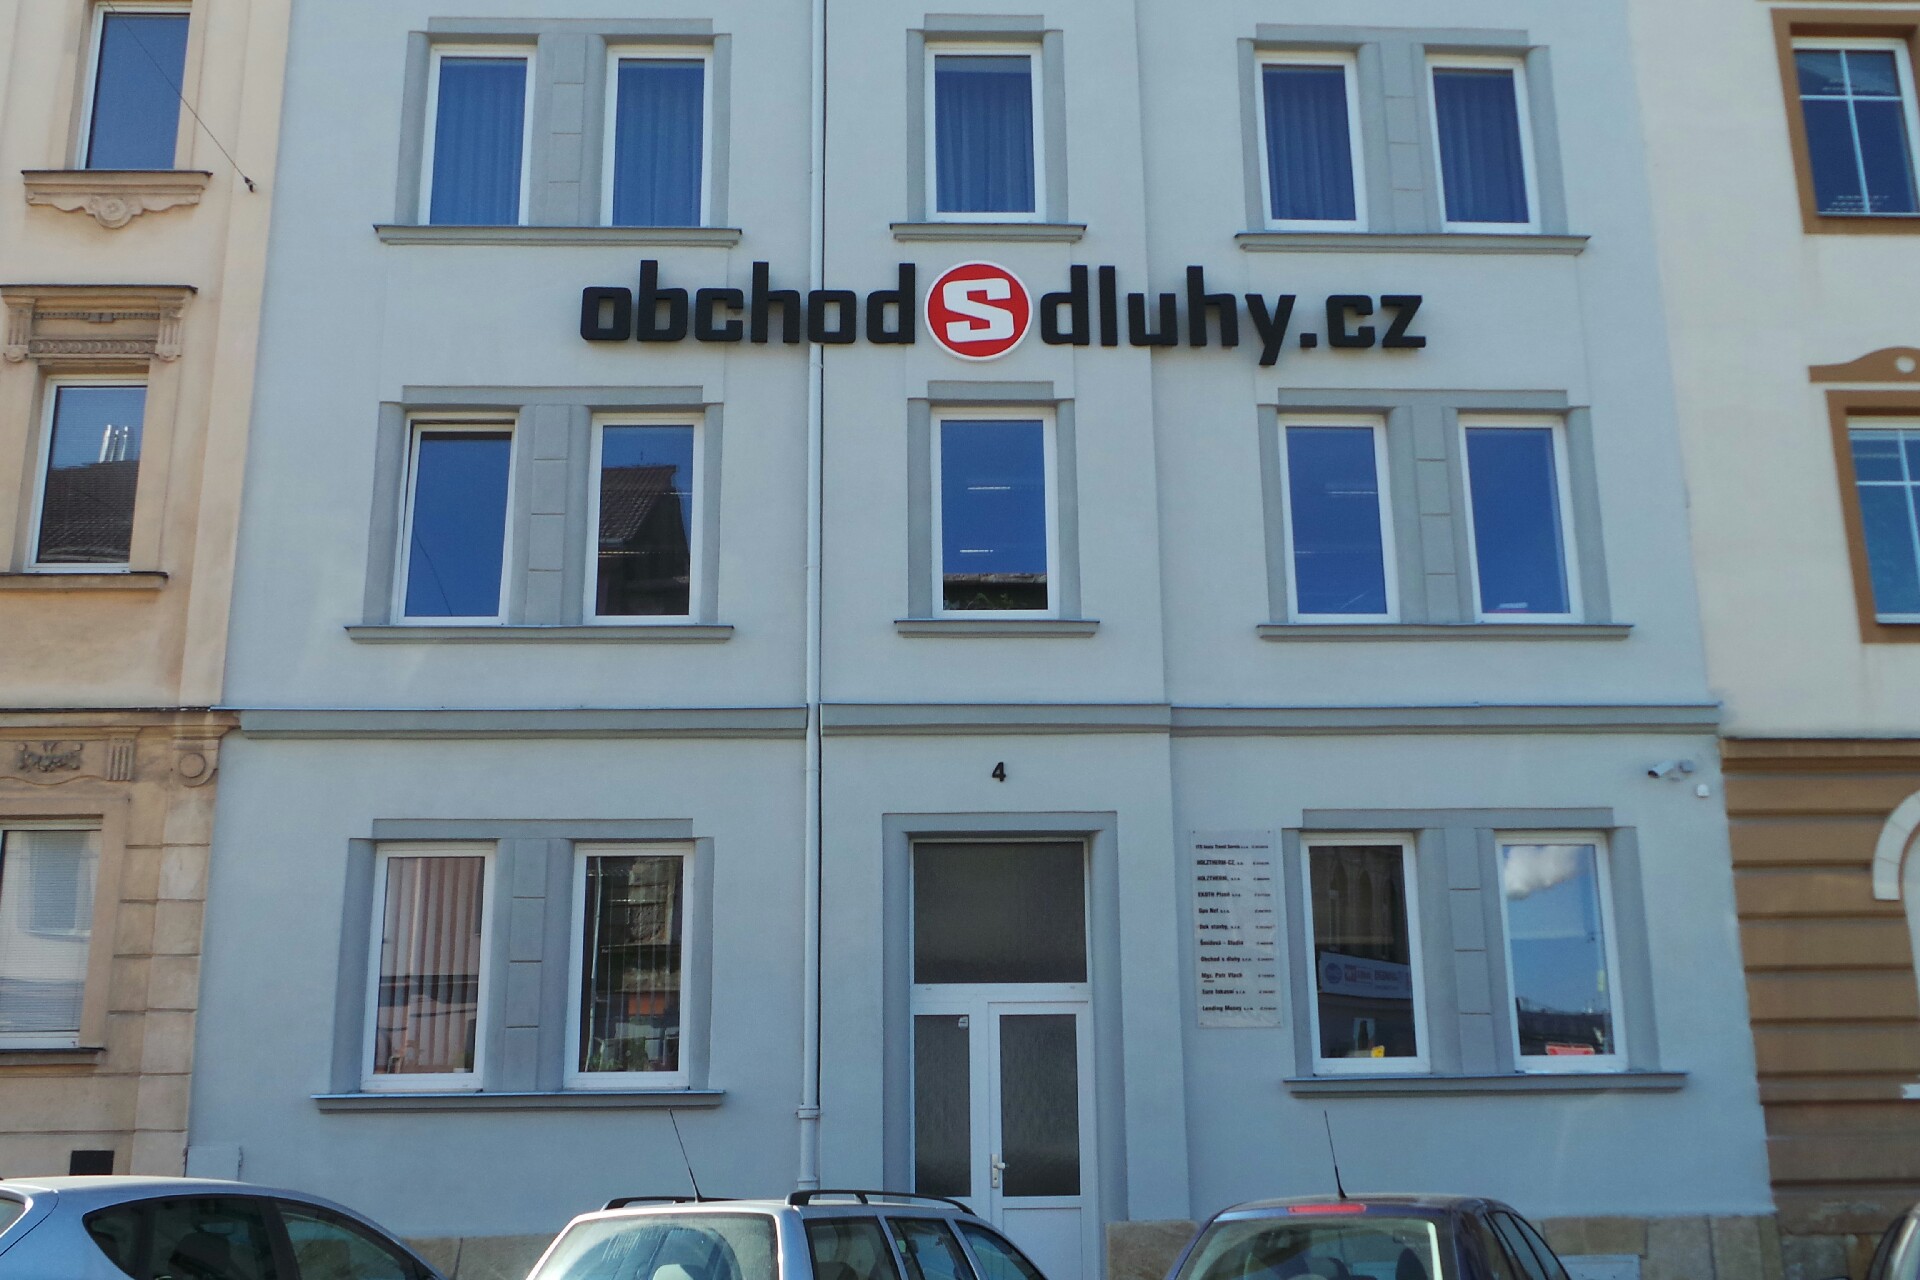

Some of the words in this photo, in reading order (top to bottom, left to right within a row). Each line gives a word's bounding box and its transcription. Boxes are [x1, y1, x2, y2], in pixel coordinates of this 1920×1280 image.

[580, 260, 915, 344] obchod
[1040, 265, 1426, 365] dluhy.cz
[992, 761, 1006, 782] 4
